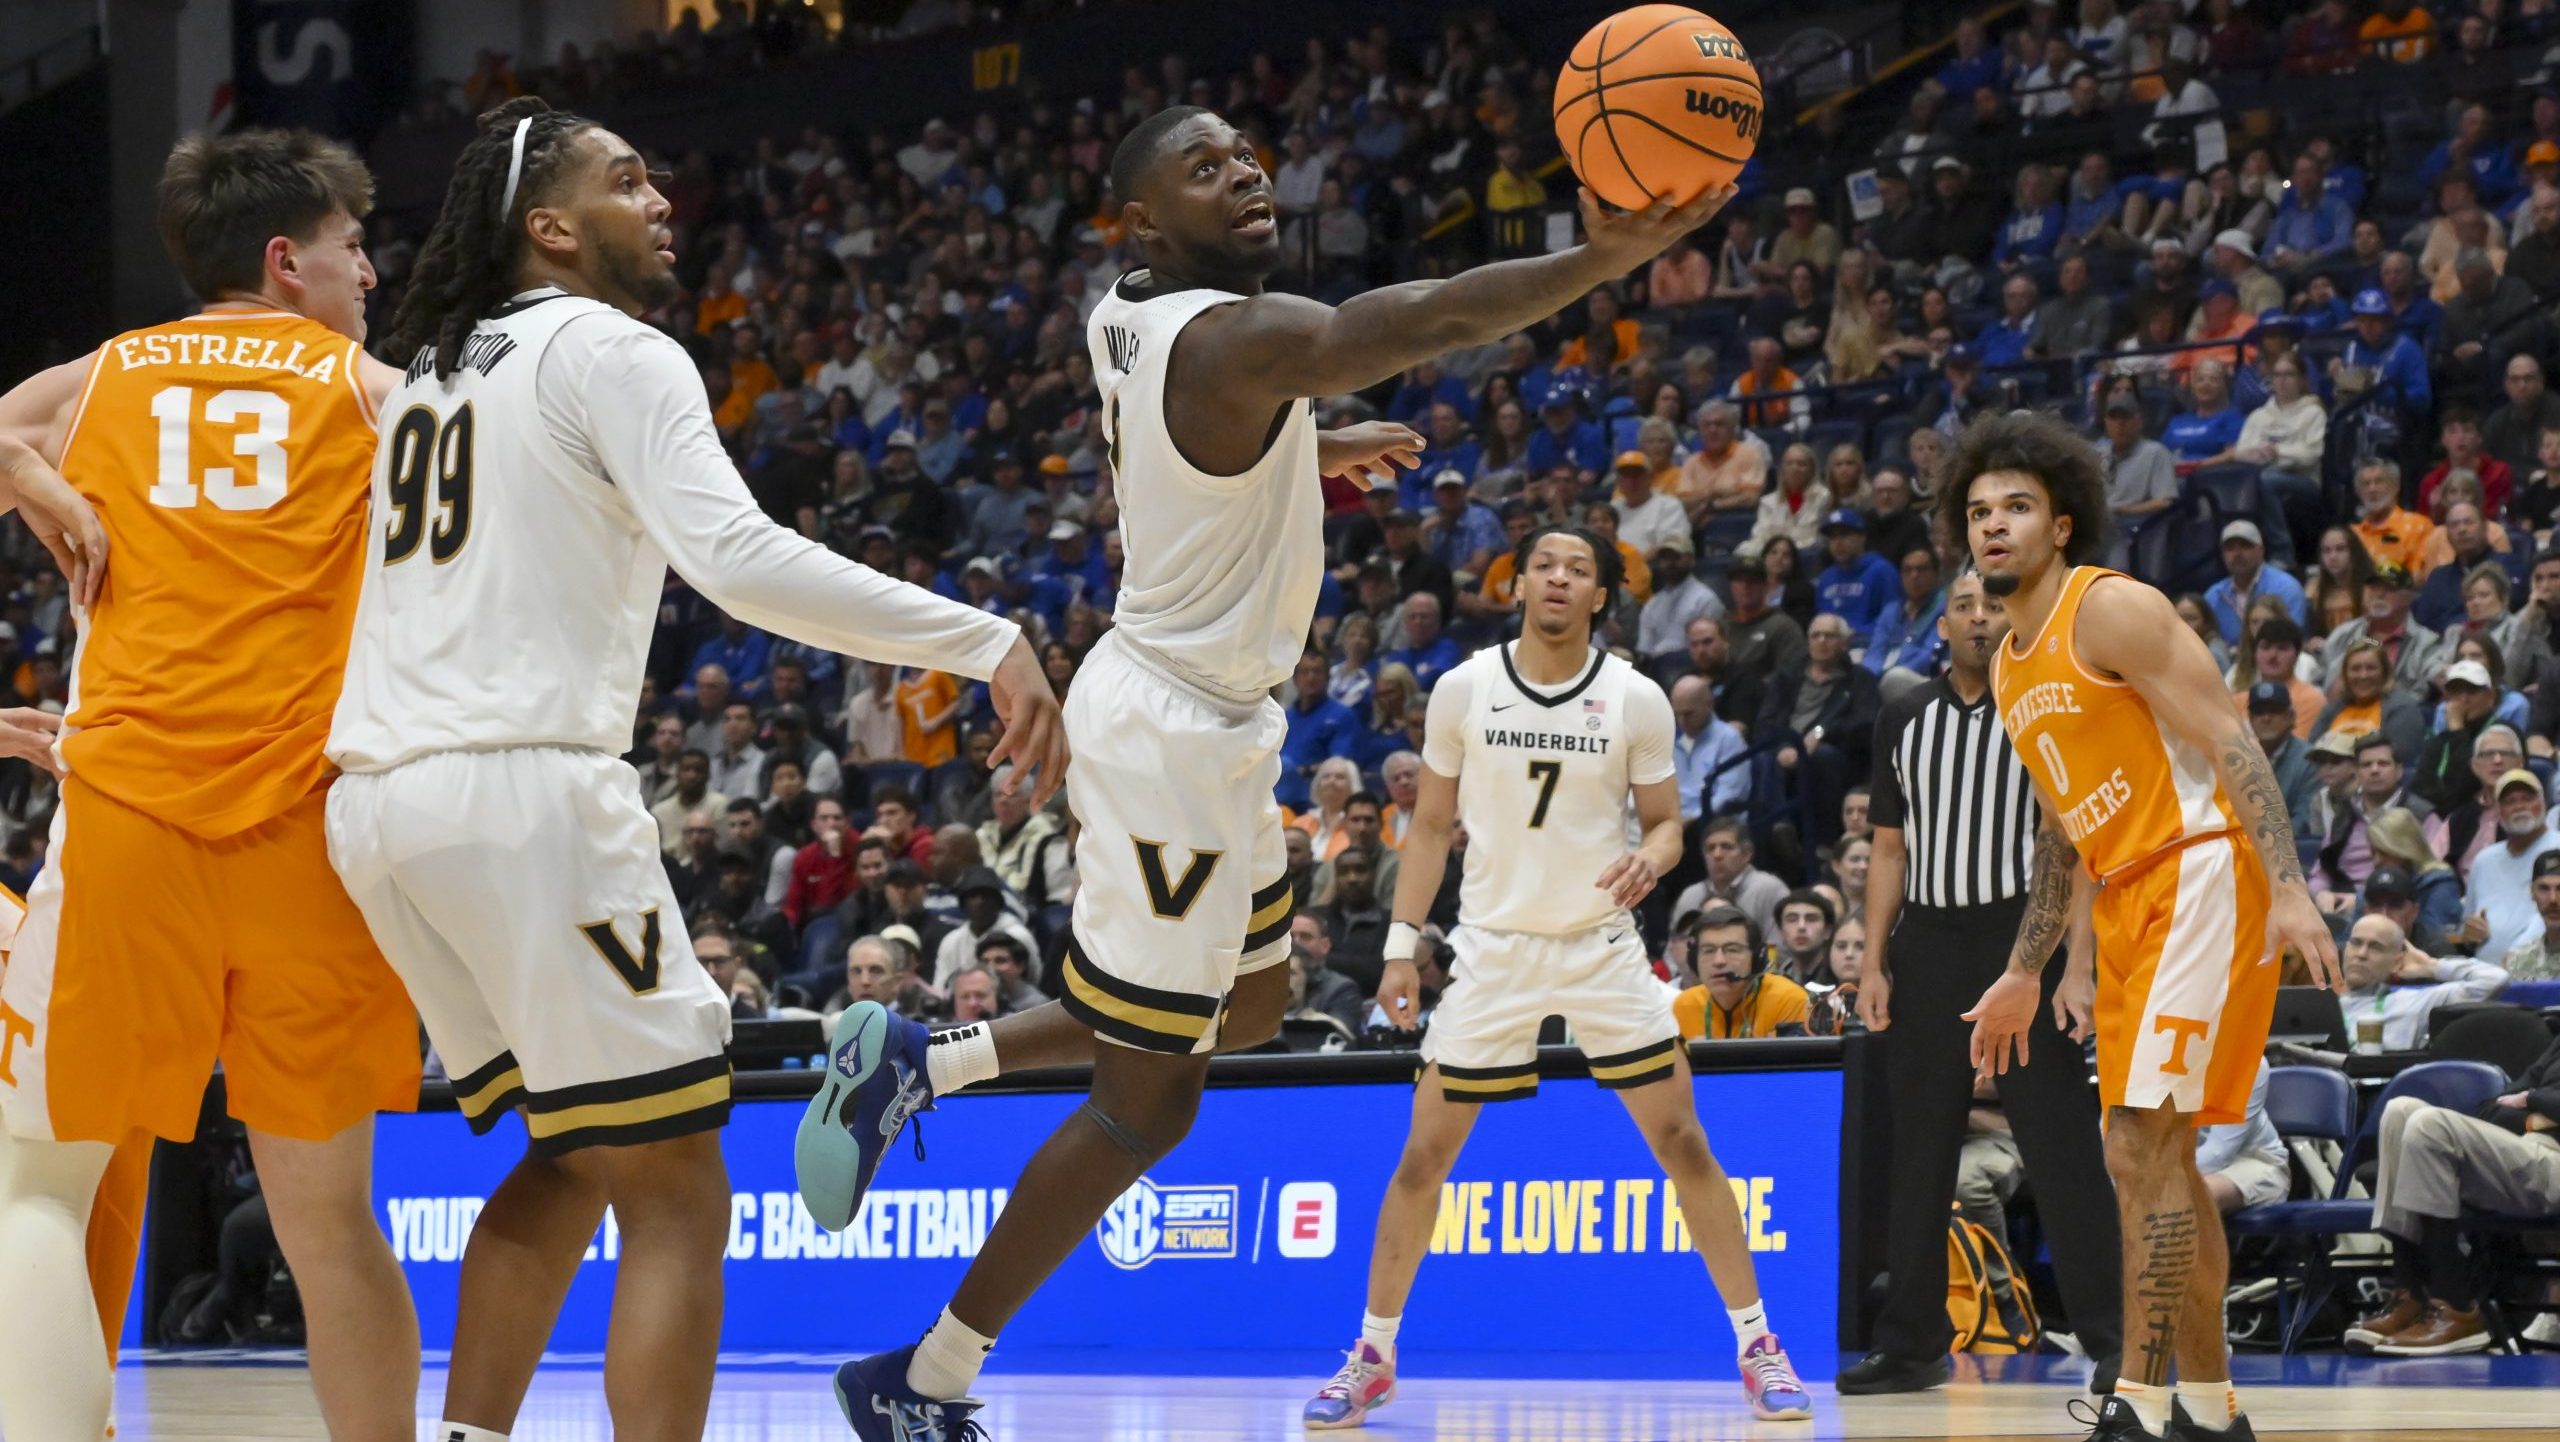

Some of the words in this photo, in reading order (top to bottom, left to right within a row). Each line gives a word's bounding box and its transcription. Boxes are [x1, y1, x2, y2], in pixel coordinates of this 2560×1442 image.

[115, 333, 338, 384] ESTRELLA
[1103, 325, 1140, 376] MILES
[150, 386, 290, 510] 13
[383, 399, 475, 567] 99
[1485, 729, 1609, 754] VANDERBILT
[2036, 731, 2069, 797] 0
[1527, 759, 1562, 829] 7
[1128, 833, 1226, 921] V
[575, 903, 662, 997] V
[2153, 1014, 2210, 1076] T
[1103, 1179, 1162, 1263] SEC
[1163, 1228, 1230, 1250] NETWORK
[1164, 1193, 1231, 1219] ESPN
[1429, 1181, 1493, 1255] WE
[1501, 1179, 1604, 1254] LOVE
[1613, 1178, 1654, 1252] IT
